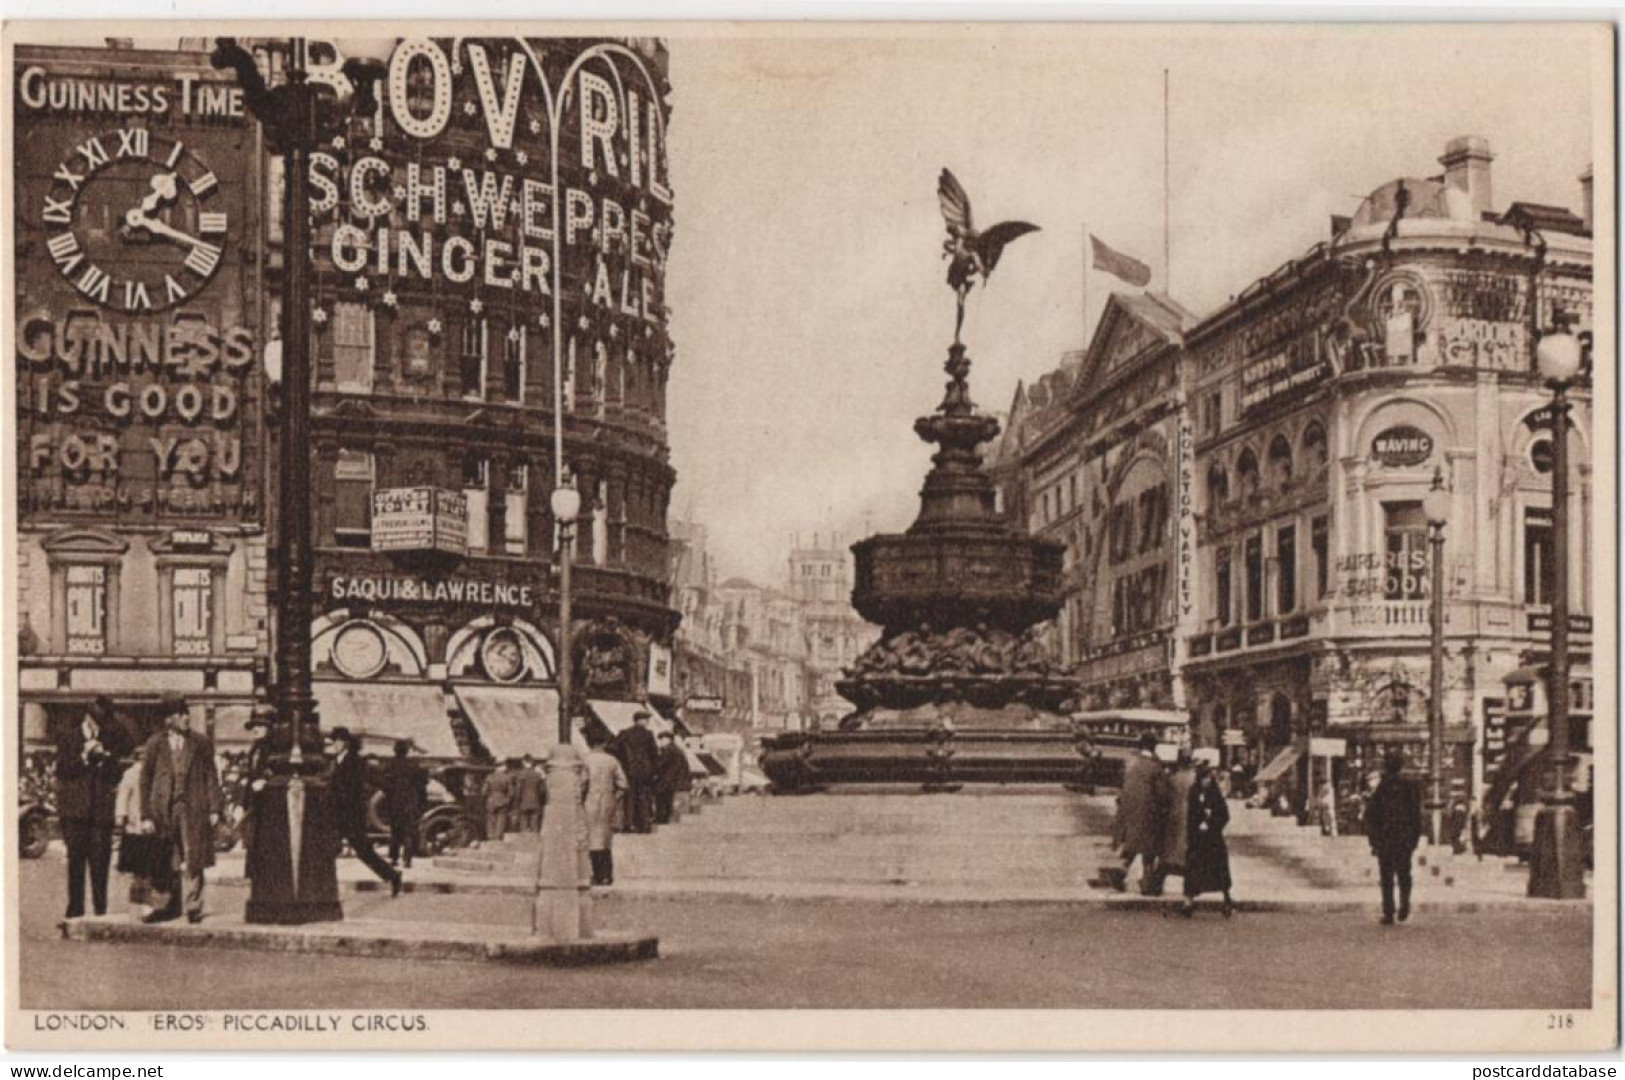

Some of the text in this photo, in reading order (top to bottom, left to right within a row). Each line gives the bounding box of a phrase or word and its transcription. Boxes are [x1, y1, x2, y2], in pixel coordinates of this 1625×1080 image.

[20, 66, 169, 114] GUINNESS
[76, 136, 109, 169] XI
[116, 129, 149, 157] XII
[331, 223, 552, 296] GINGER
[591, 251, 662, 323] ALE
[37, 377, 238, 420] IS GOOD
[30, 433, 118, 472] FOR
